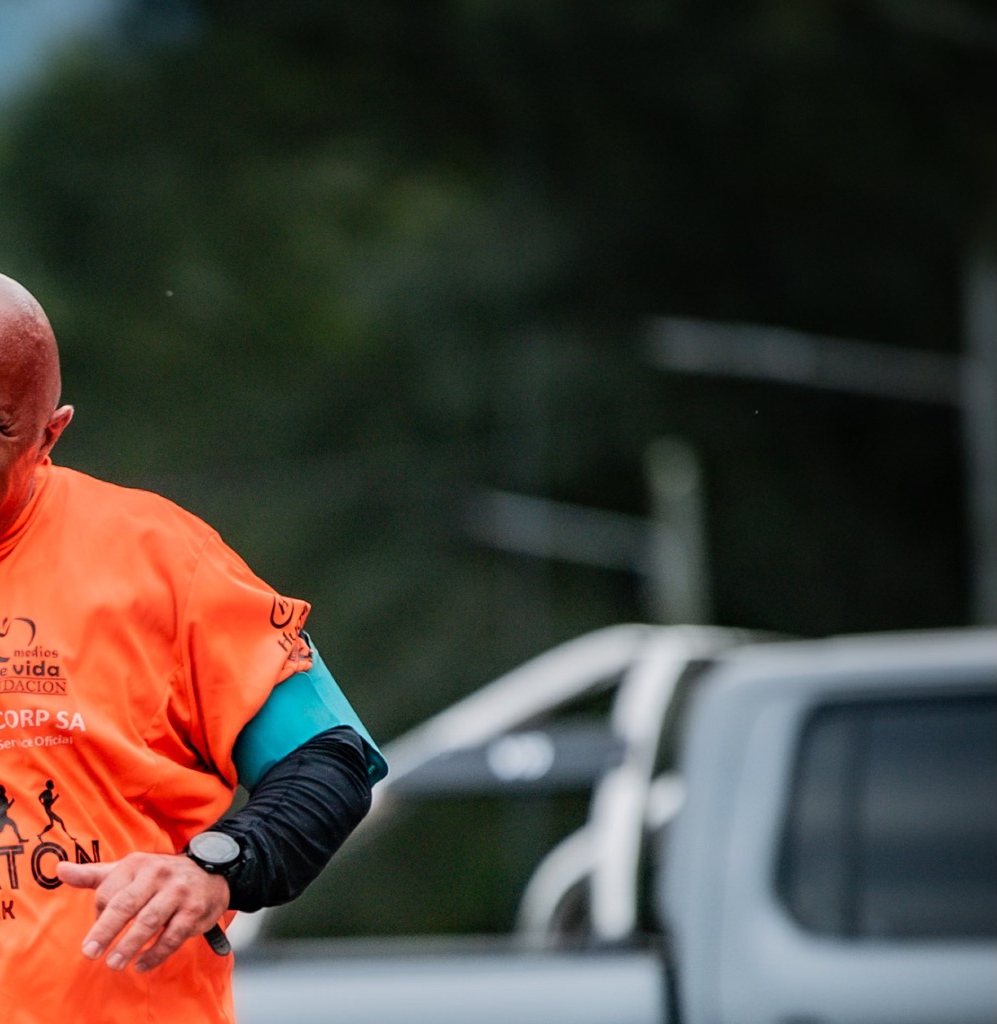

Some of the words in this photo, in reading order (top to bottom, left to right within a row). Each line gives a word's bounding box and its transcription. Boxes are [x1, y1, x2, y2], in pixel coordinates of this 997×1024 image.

[13, 645, 59, 658] medios
[12, 660, 60, 677] vida
[55, 710, 86, 732] SA
